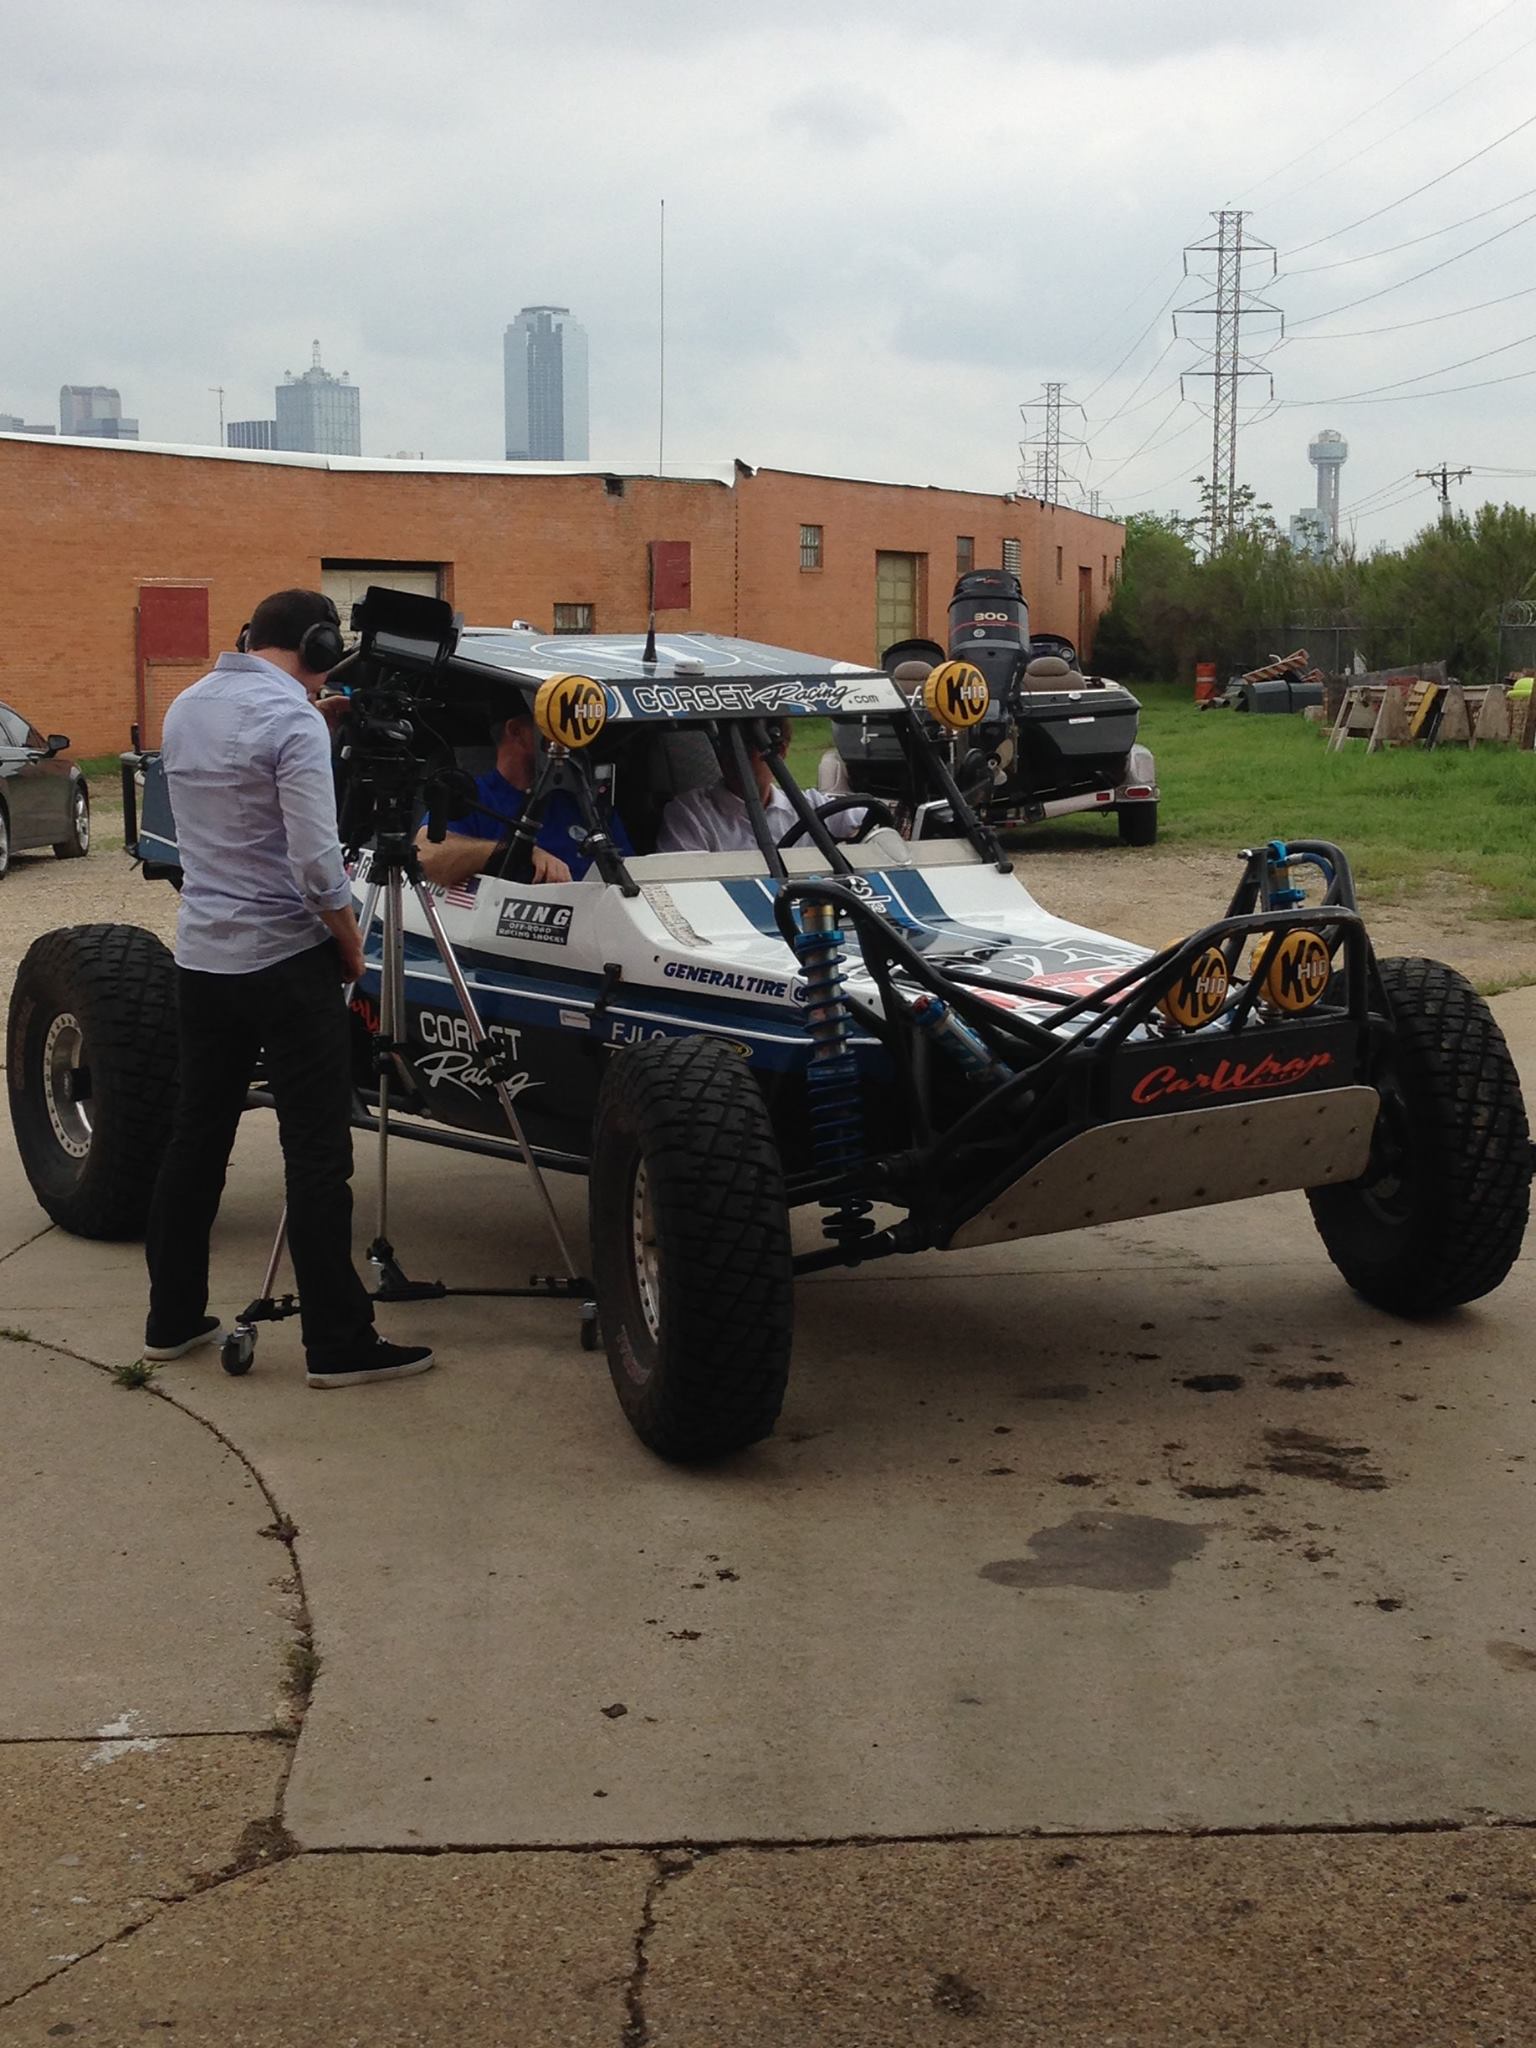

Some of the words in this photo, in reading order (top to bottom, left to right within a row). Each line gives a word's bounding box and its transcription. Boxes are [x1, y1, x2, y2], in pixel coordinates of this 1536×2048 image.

[633, 684, 755, 713] CORBET
[947, 668, 984, 720] KC
[960, 686, 986, 700] HID
[560, 684, 601, 740] KC
[574, 703, 603, 719] HID
[502, 902, 571, 926] KING
[1281, 939, 1325, 1003] KC
[1297, 960, 1328, 980] HID
[1196, 976, 1227, 994] HID
